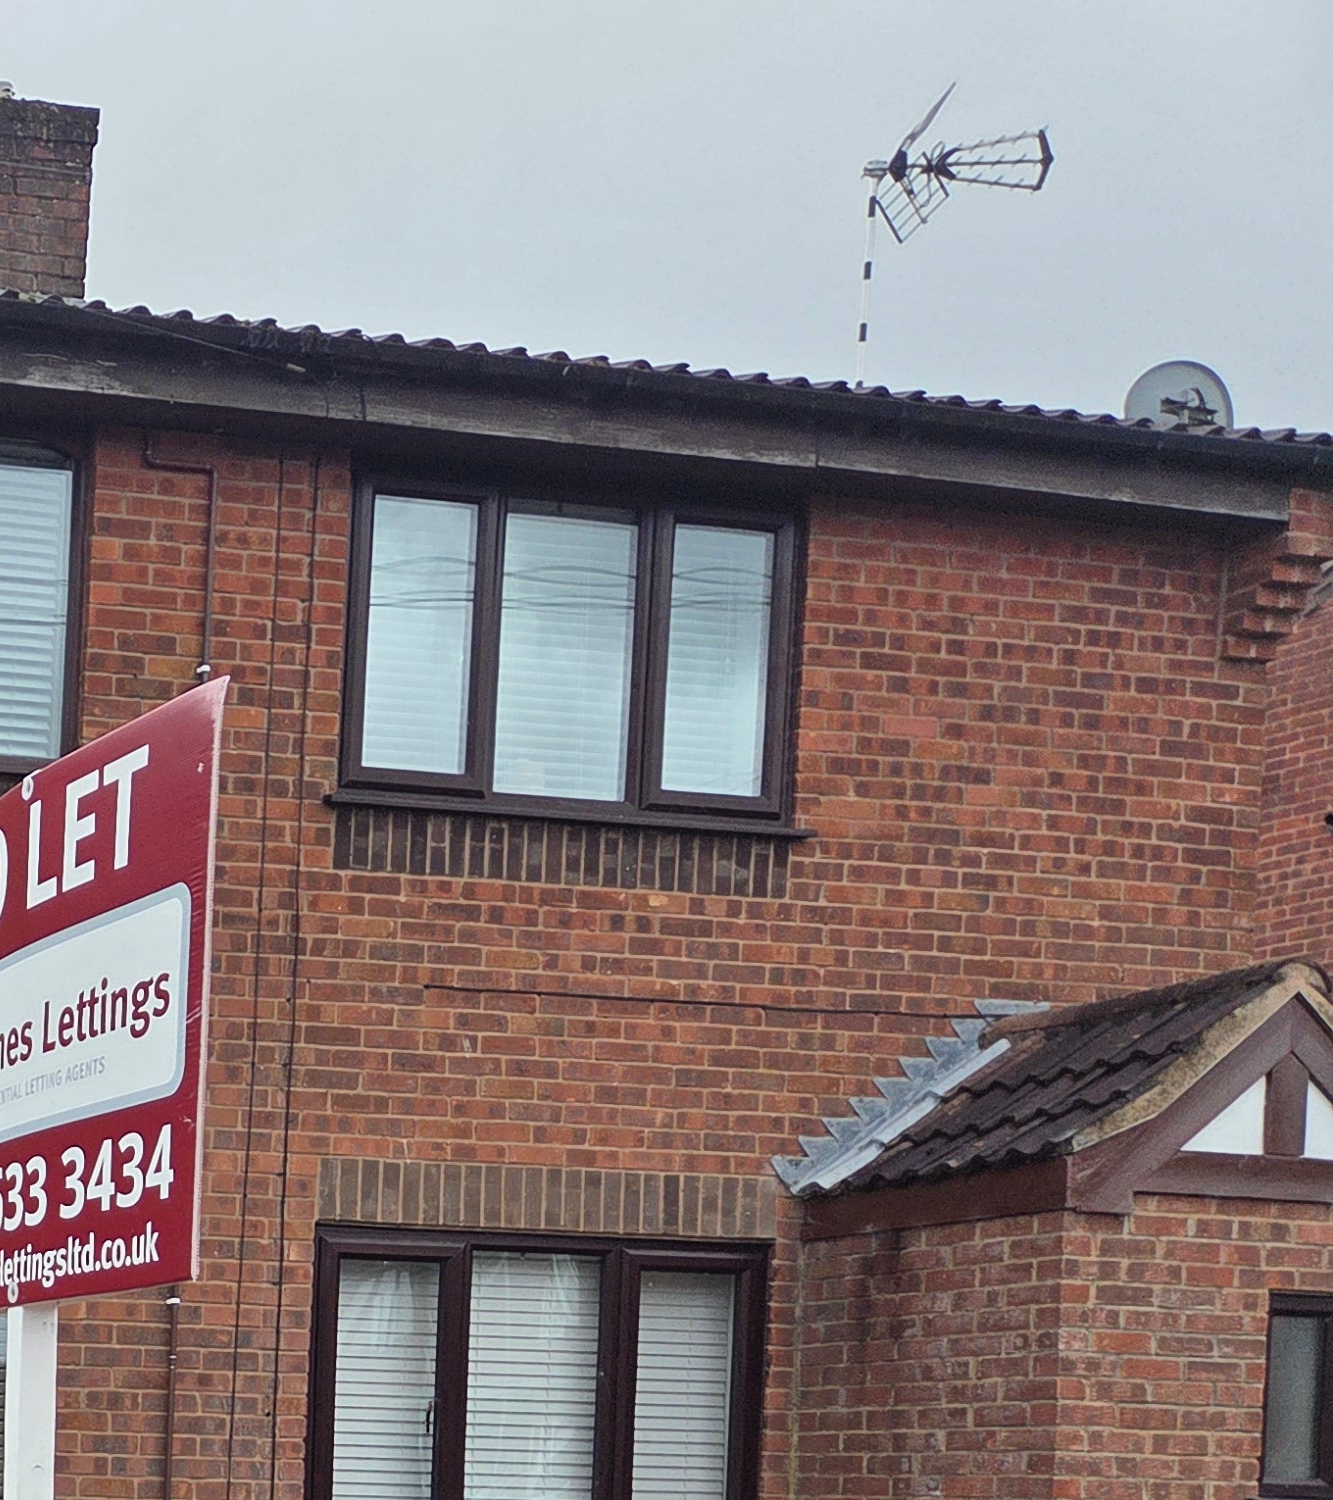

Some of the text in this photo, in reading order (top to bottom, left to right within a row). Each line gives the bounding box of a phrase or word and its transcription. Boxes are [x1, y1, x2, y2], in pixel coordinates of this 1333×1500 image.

[26, 744, 149, 910] LET
[42, 972, 170, 1053] Lettings
[25, 1069, 63, 1096] LETTING
[65, 1056, 106, 1086] AGENTS
[59, 1123, 174, 1219] 3434
